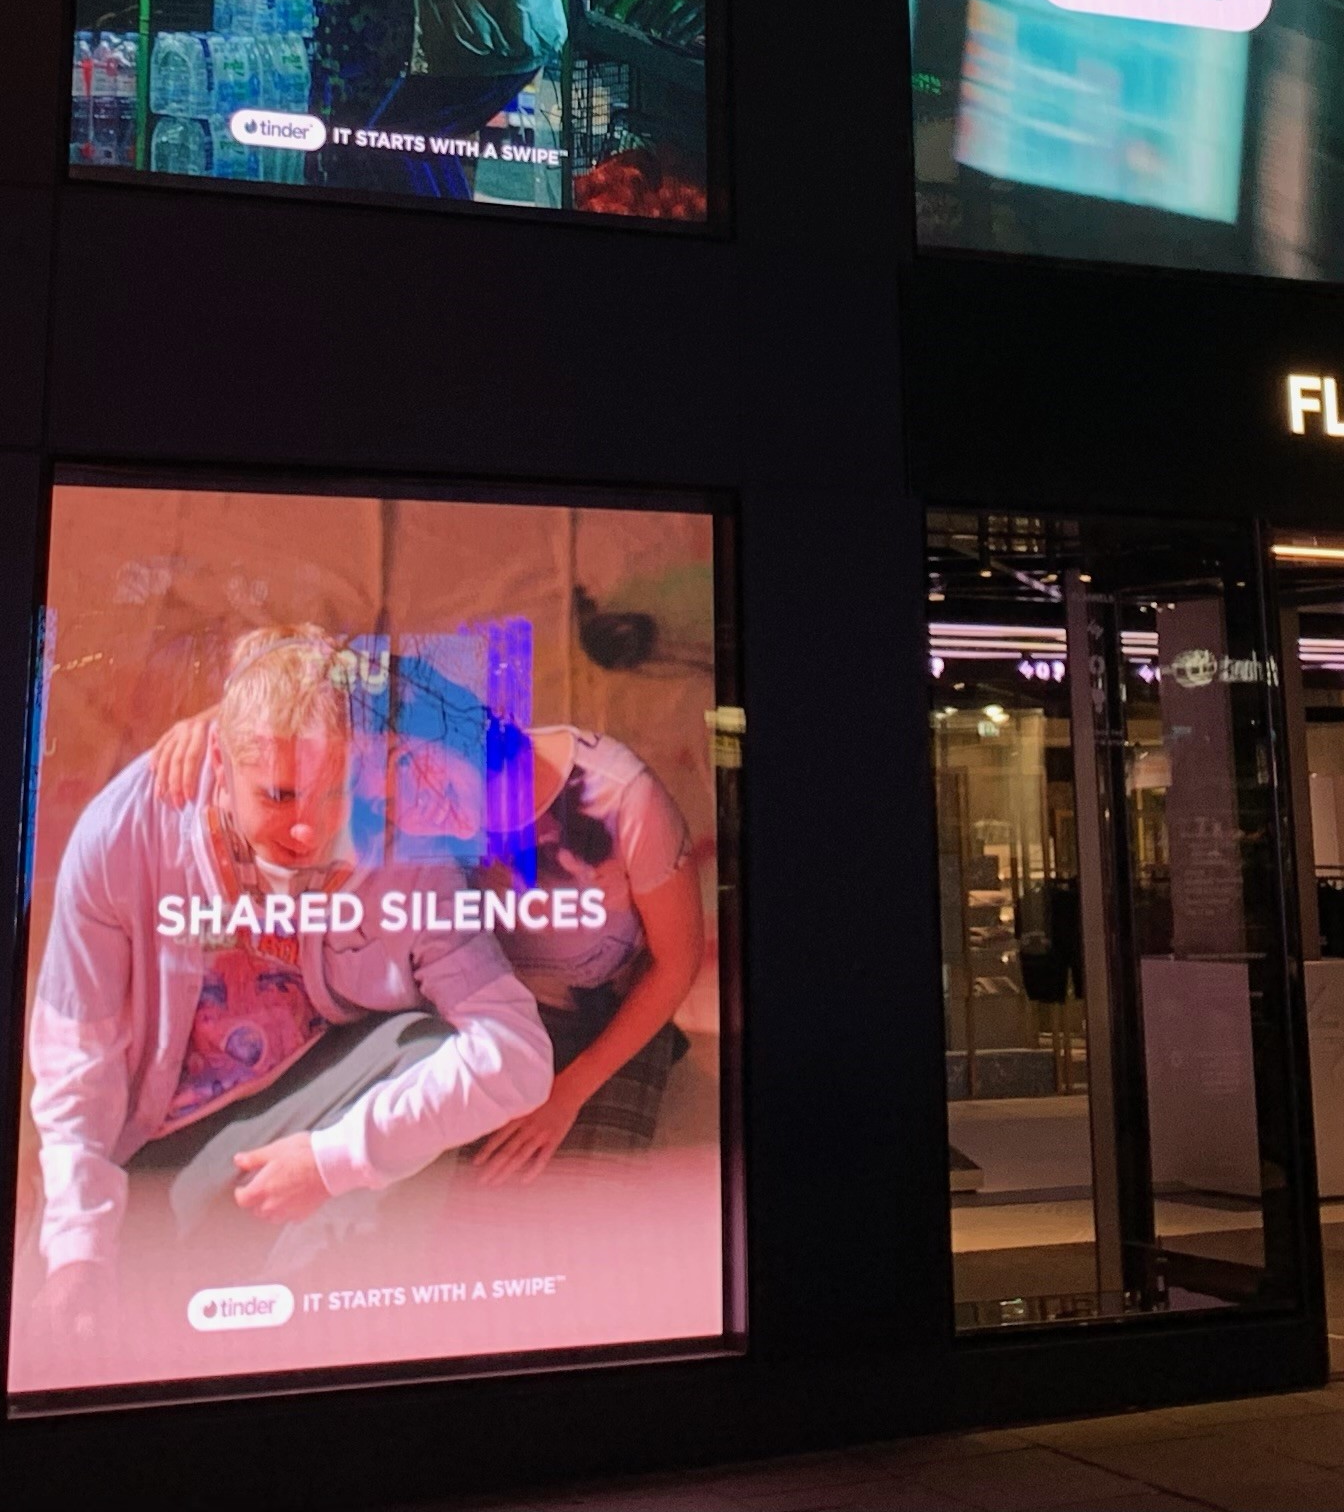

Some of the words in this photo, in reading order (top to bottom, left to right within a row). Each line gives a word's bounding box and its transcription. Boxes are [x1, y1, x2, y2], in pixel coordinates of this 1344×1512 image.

[333, 127, 352, 145] IT
[355, 129, 426, 153] STARTS
[429, 137, 480, 158] WITH
[482, 143, 498, 160] A
[156, 892, 364, 936] SHARED
[381, 888, 607, 933] SILENCES
[303, 1293, 323, 1312] IT
[328, 1288, 406, 1312] STARTS
[411, 1282, 467, 1304] WITH
[471, 1281, 488, 1301] A
